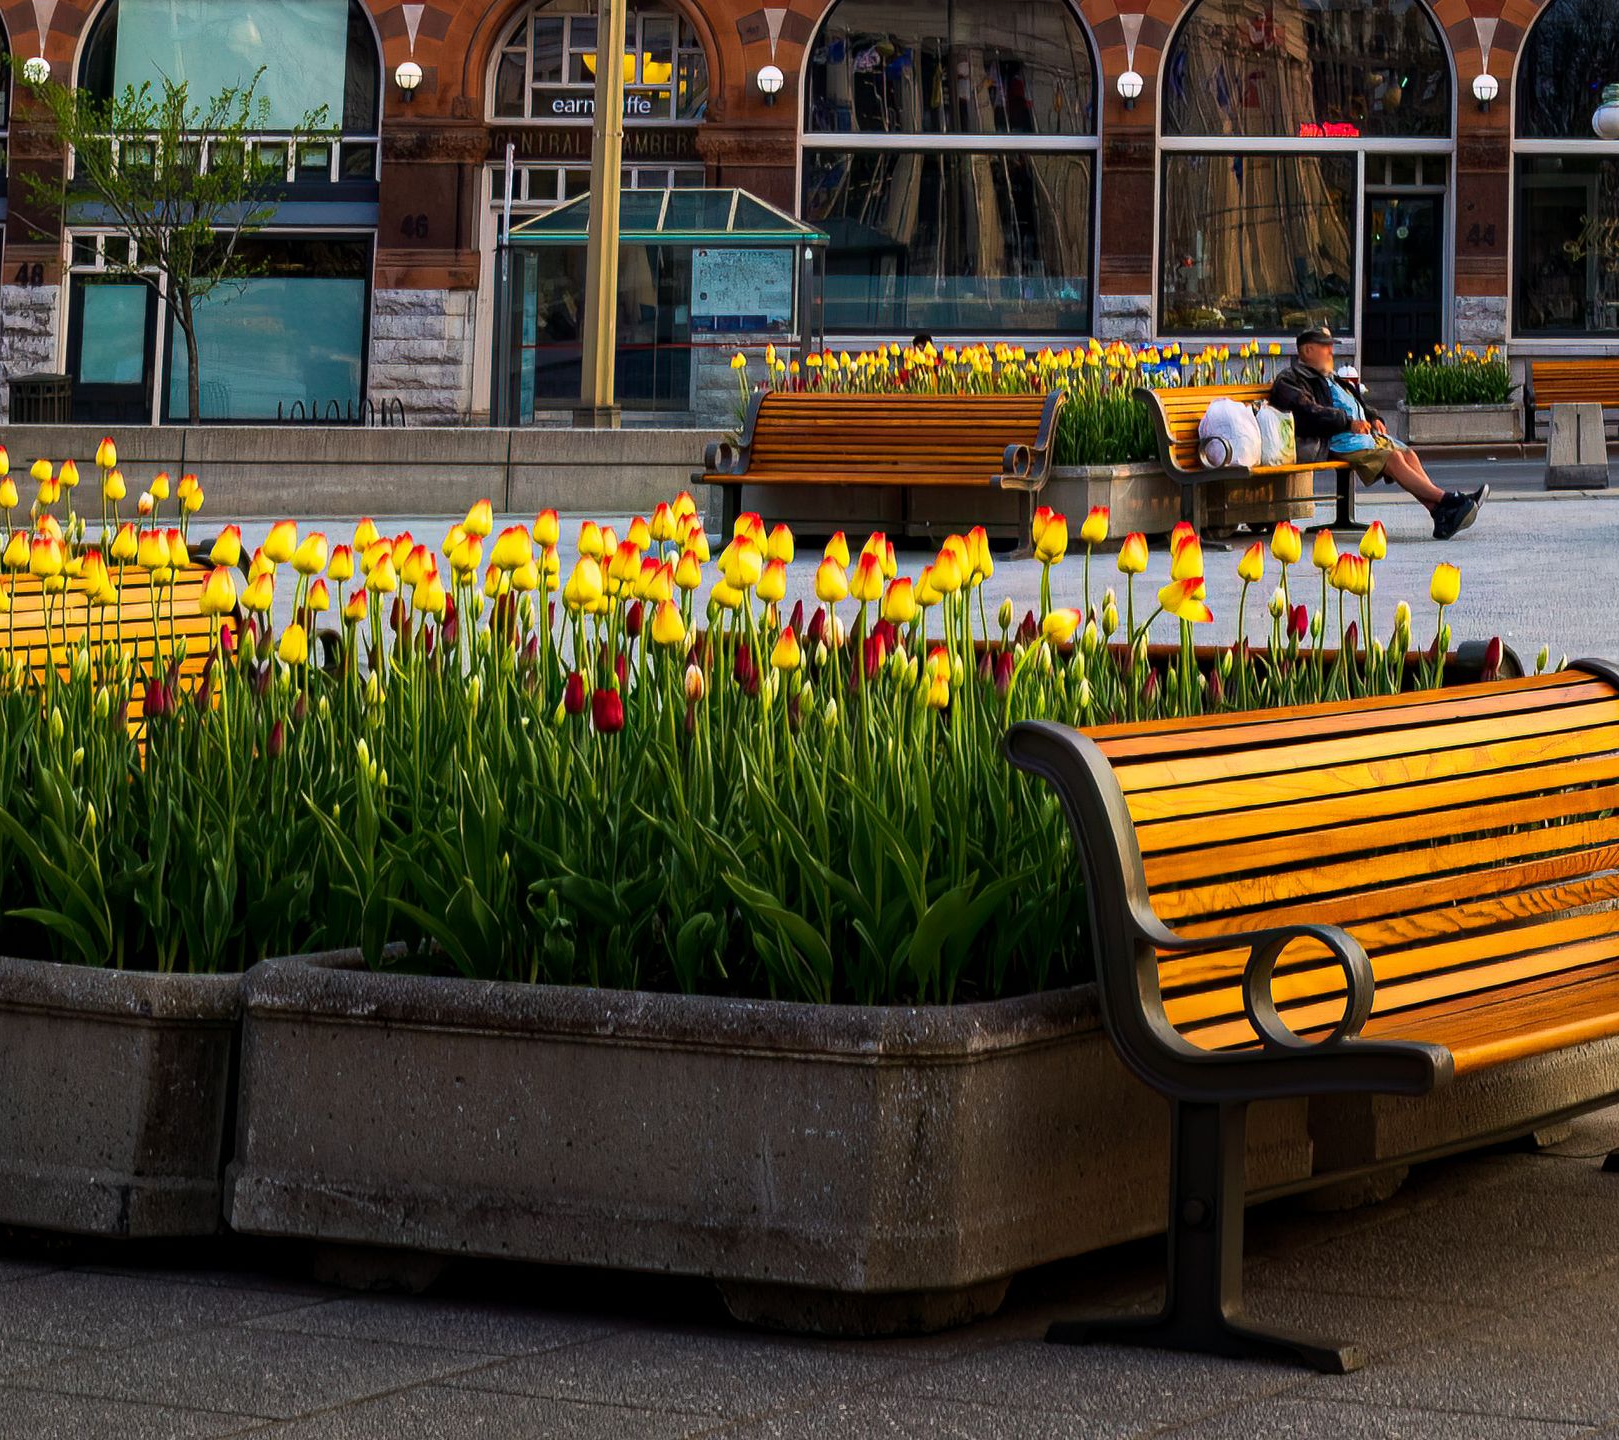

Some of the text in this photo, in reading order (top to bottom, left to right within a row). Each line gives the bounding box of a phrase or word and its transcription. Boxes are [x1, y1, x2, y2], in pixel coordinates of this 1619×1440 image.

[400, 214, 428, 239] 46
[1467, 223, 1496, 248] 44
[15, 261, 45, 287] 48
